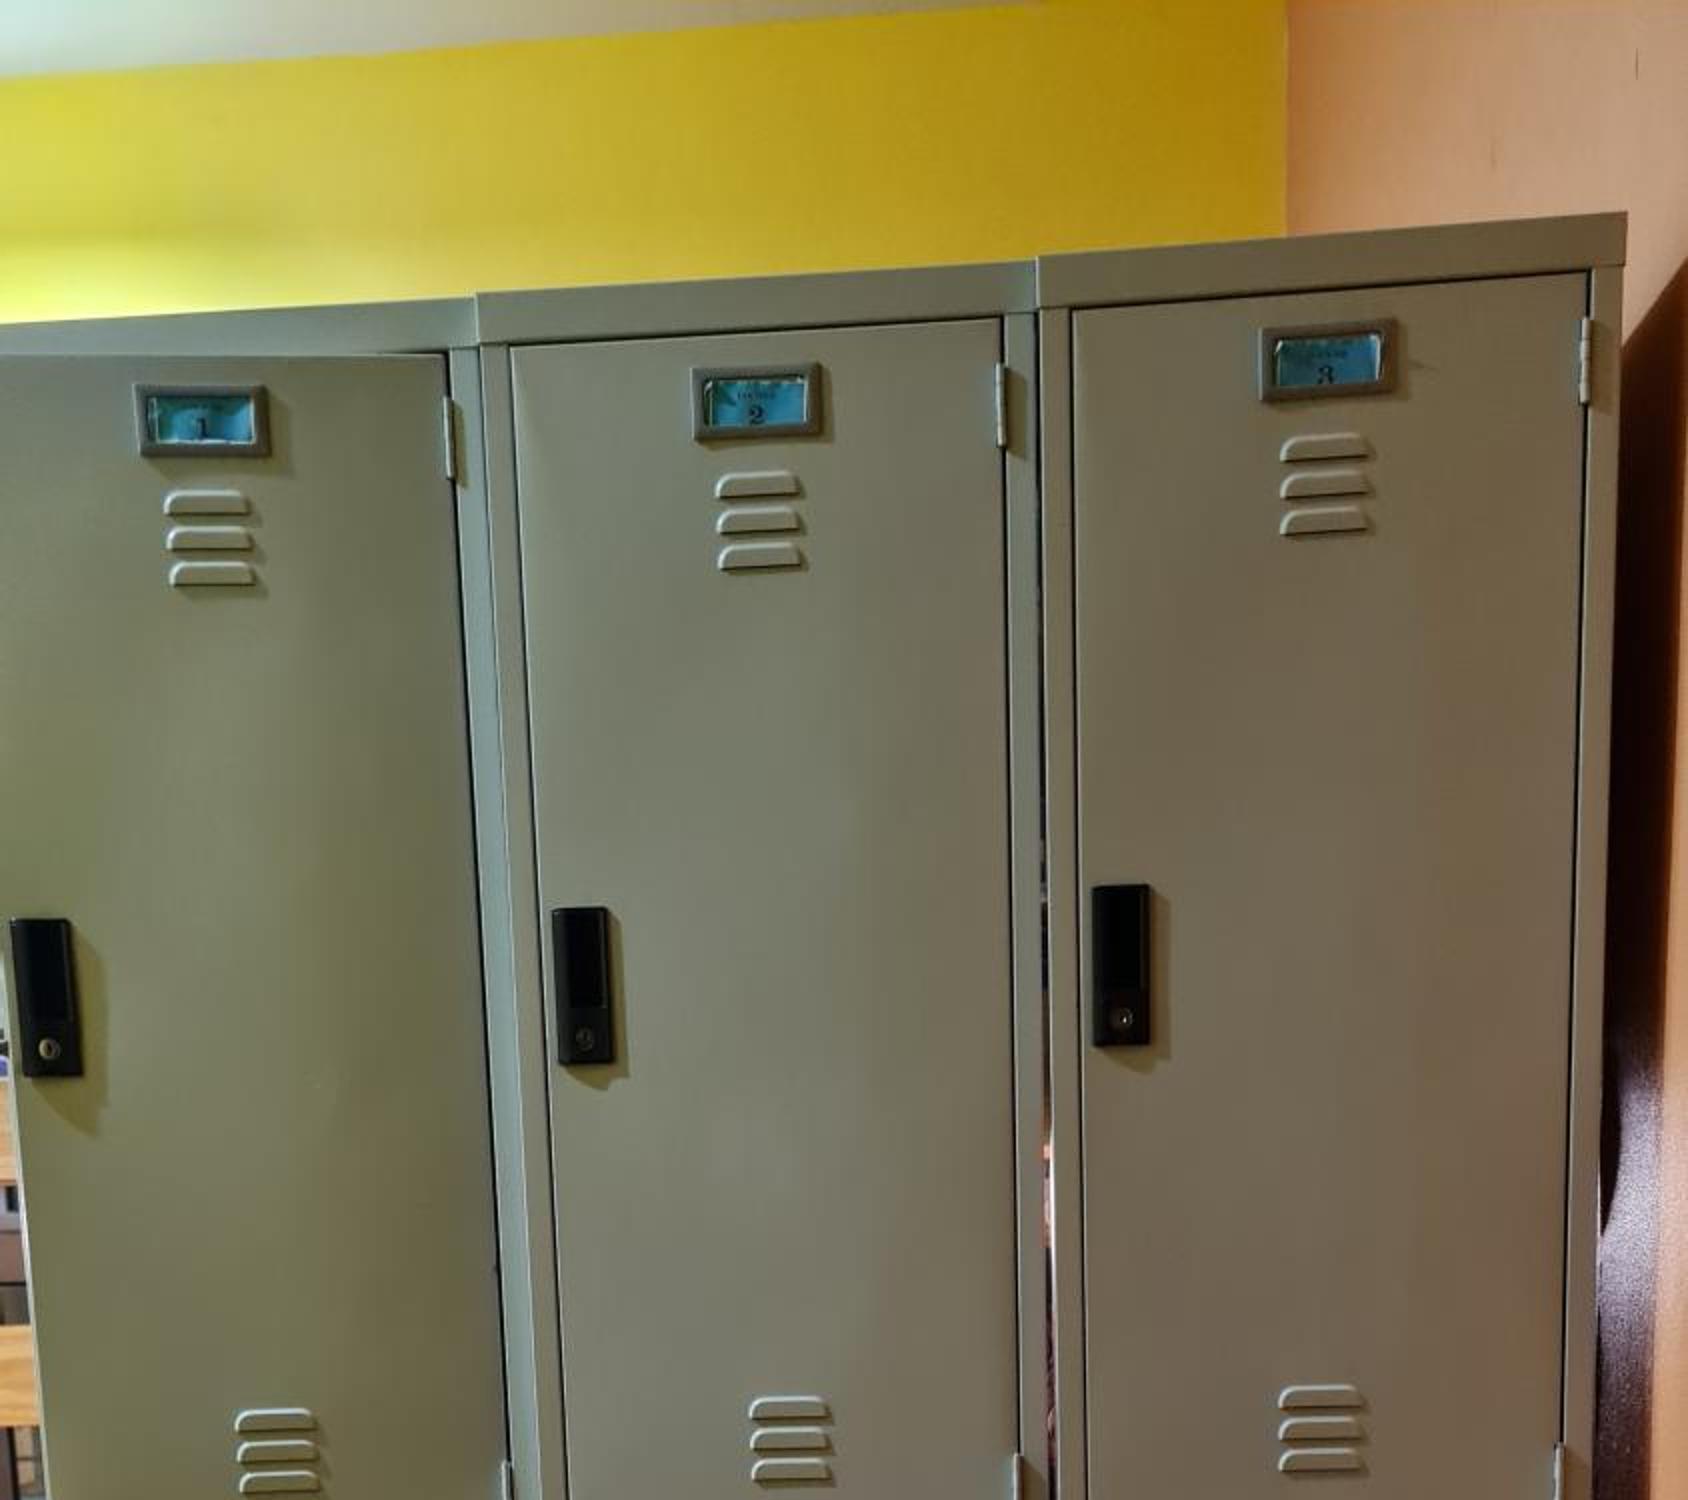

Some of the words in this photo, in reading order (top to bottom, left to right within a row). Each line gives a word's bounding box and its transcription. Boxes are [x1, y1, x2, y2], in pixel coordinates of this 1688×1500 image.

[1317, 363, 1334, 385] 3
[749, 404, 765, 424] 2
[195, 417, 208, 439] 1
